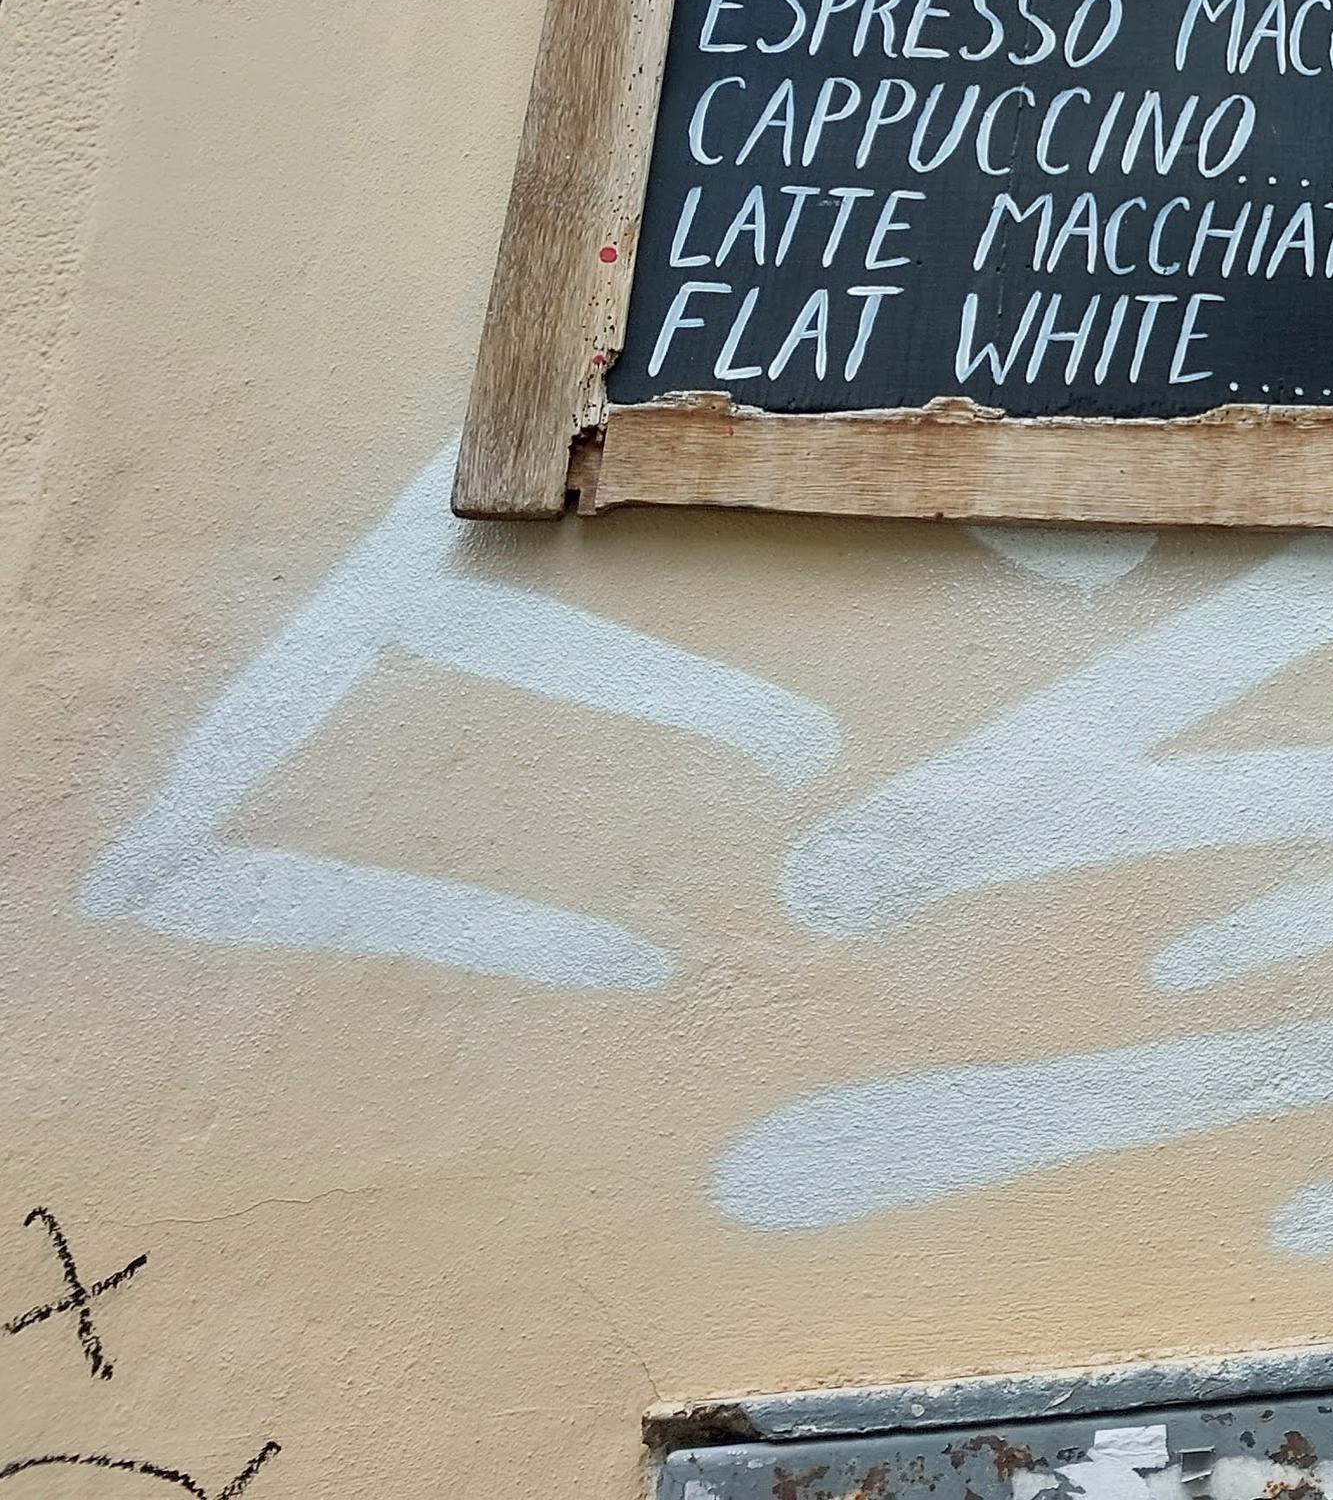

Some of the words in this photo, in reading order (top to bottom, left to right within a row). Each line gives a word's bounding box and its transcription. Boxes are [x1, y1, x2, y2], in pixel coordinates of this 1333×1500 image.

[688, 77, 1256, 178] CAPPUCCINO
[670, 185, 926, 268] LATTE
[648, 281, 903, 382] FLAT
[955, 290, 1224, 385] WHITE
